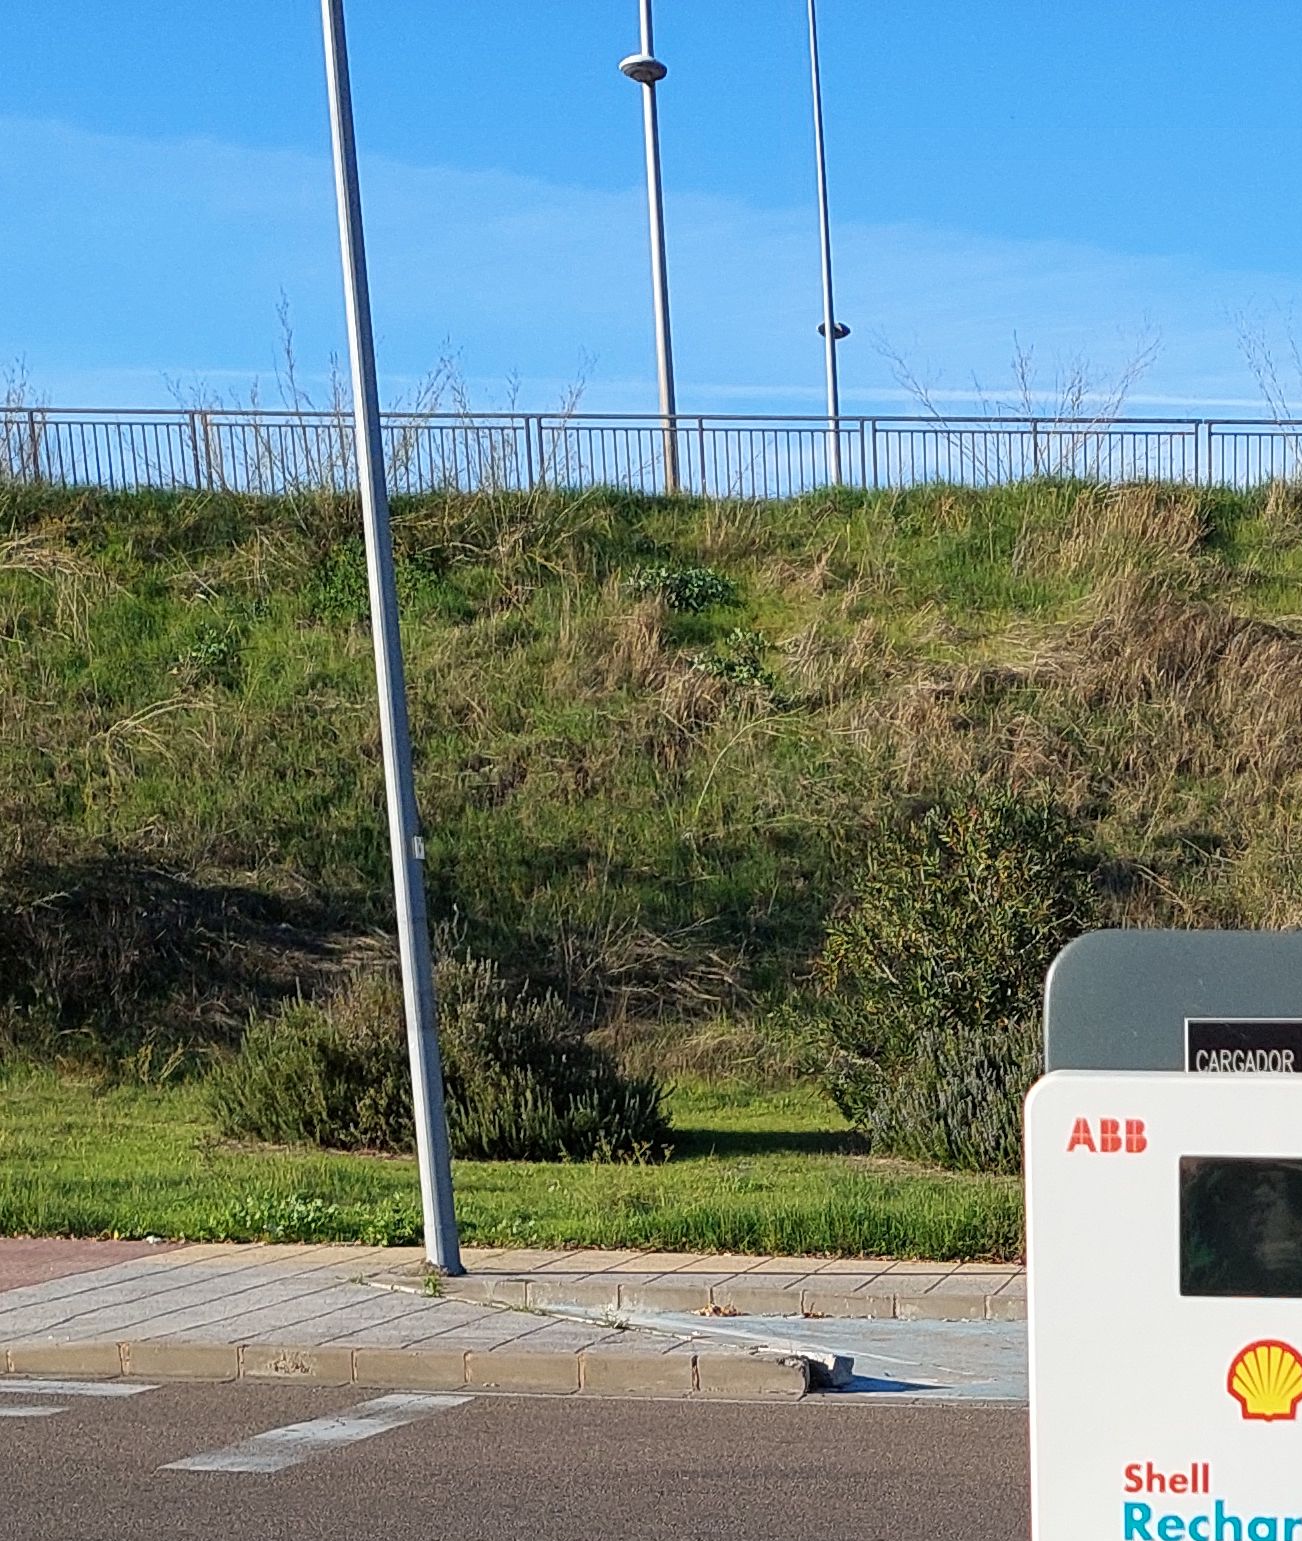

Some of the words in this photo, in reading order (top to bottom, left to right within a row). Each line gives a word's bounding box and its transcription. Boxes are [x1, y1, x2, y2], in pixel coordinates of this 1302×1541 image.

[1196, 1049, 1295, 1073] CARGADOR
[1067, 1117, 1148, 1153] ABB
[1123, 1462, 1210, 1494] Shell
